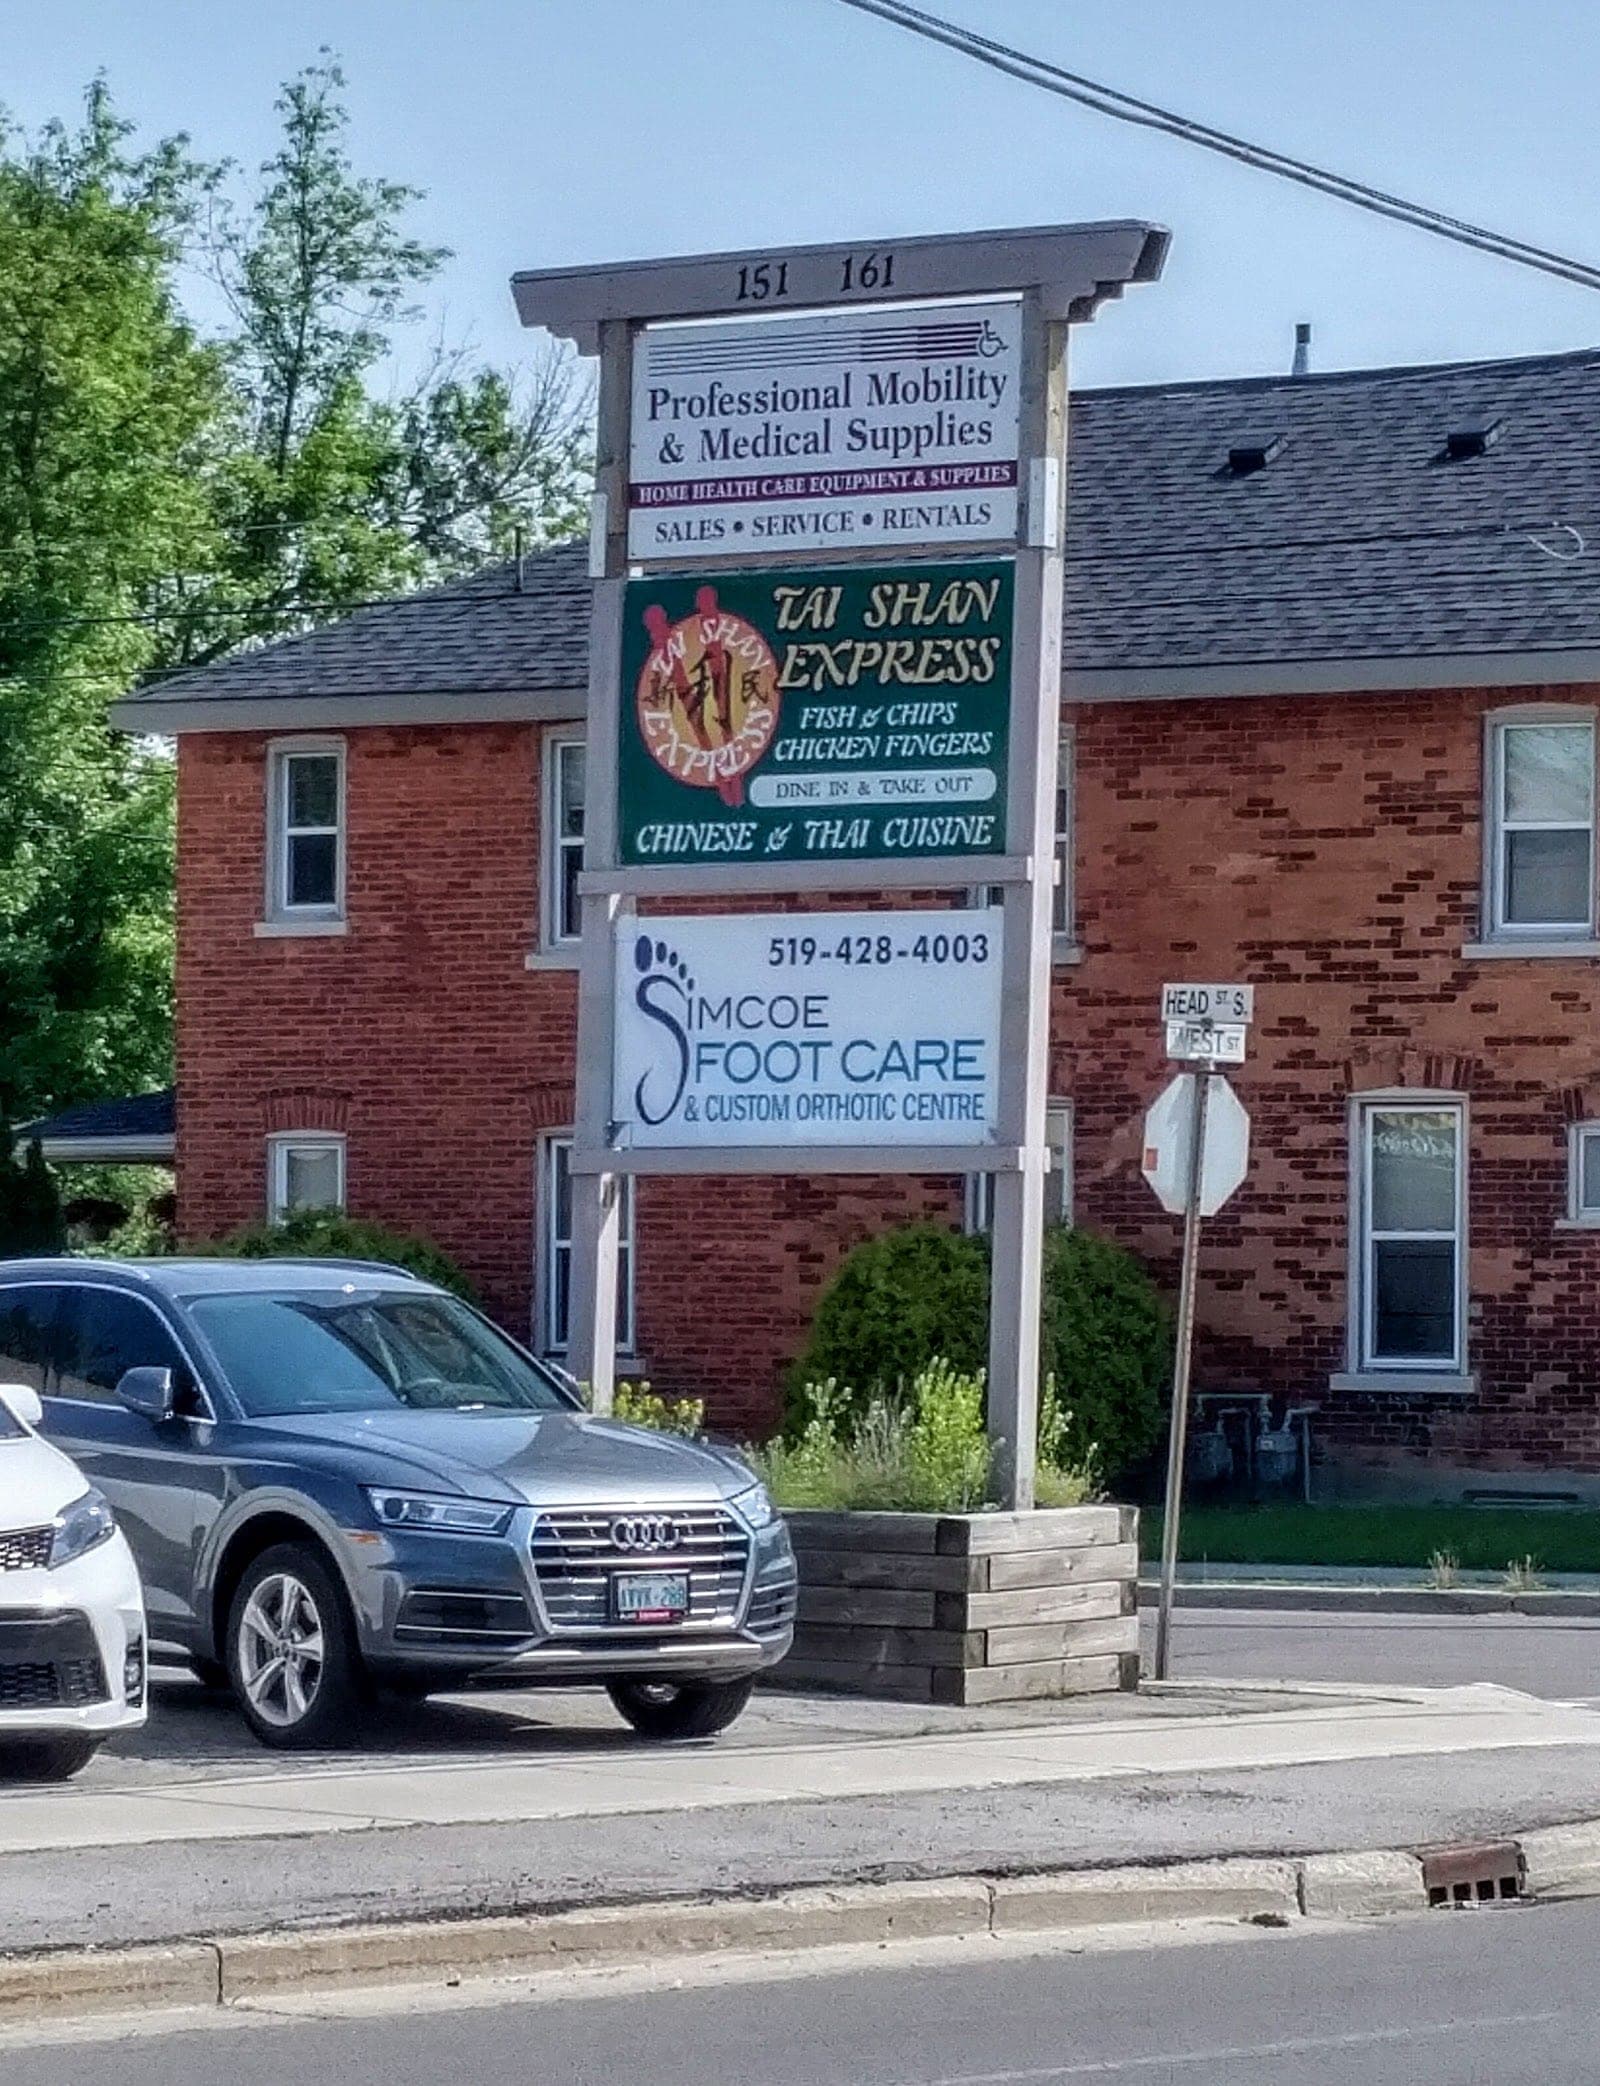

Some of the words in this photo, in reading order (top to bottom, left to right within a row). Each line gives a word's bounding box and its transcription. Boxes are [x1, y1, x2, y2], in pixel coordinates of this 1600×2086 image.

[737, 262, 789, 300] 151
[841, 254, 895, 292] 161
[647, 372, 851, 421] Professional
[867, 365, 1008, 408] Mobility
[658, 433, 685, 463] &
[699, 419, 831, 462] Medical
[846, 411, 993, 459] Supplies
[639, 485, 689, 504] HOME
[692, 480, 757, 500] HEALTH
[762, 476, 806, 496] CARE
[809, 471, 911, 496] EQUIPMENT
[913, 470, 926, 487] &
[930, 465, 1012, 486] SUPPLIES
[655, 517, 725, 543] SALES
[752, 510, 854, 537] SERVICE
[883, 503, 992, 530] RENTALS
[773, 586, 844, 630] TAI
[863, 578, 1001, 628] SHAN
[776, 637, 1001, 691] EXPRESS
[800, 704, 858, 730] FISH
[859, 706, 884, 729] &
[886, 702, 958, 727] CHIPS
[774, 735, 881, 762] CHICKEN
[885, 731, 994, 758] FINGERS
[776, 781, 821, 799] DINE
[829, 780, 849, 796] IN
[857, 780, 871, 796] &
[879, 777, 926, 795] TAKE
[935, 776, 974, 794] OUT
[636, 821, 759, 854] CHINESE
[764, 823, 793, 853] &
[804, 817, 871, 849] THAI
[882, 814, 996, 849] CUISINE
[768, 934, 990, 967] 519-428-4003
[1166, 990, 1209, 1015] HEAD
[635, 974, 829, 1126] SIMCOE
[695, 1040, 833, 1084] FOOT
[841, 1039, 986, 1083] CARE
[1227, 1036, 1240, 1050] ST
[684, 1095, 700, 1122] &
[705, 1093, 791, 1122] CUSTOM
[798, 1092, 898, 1122] ORTHOTIC
[902, 1092, 986, 1121] CENTRE
